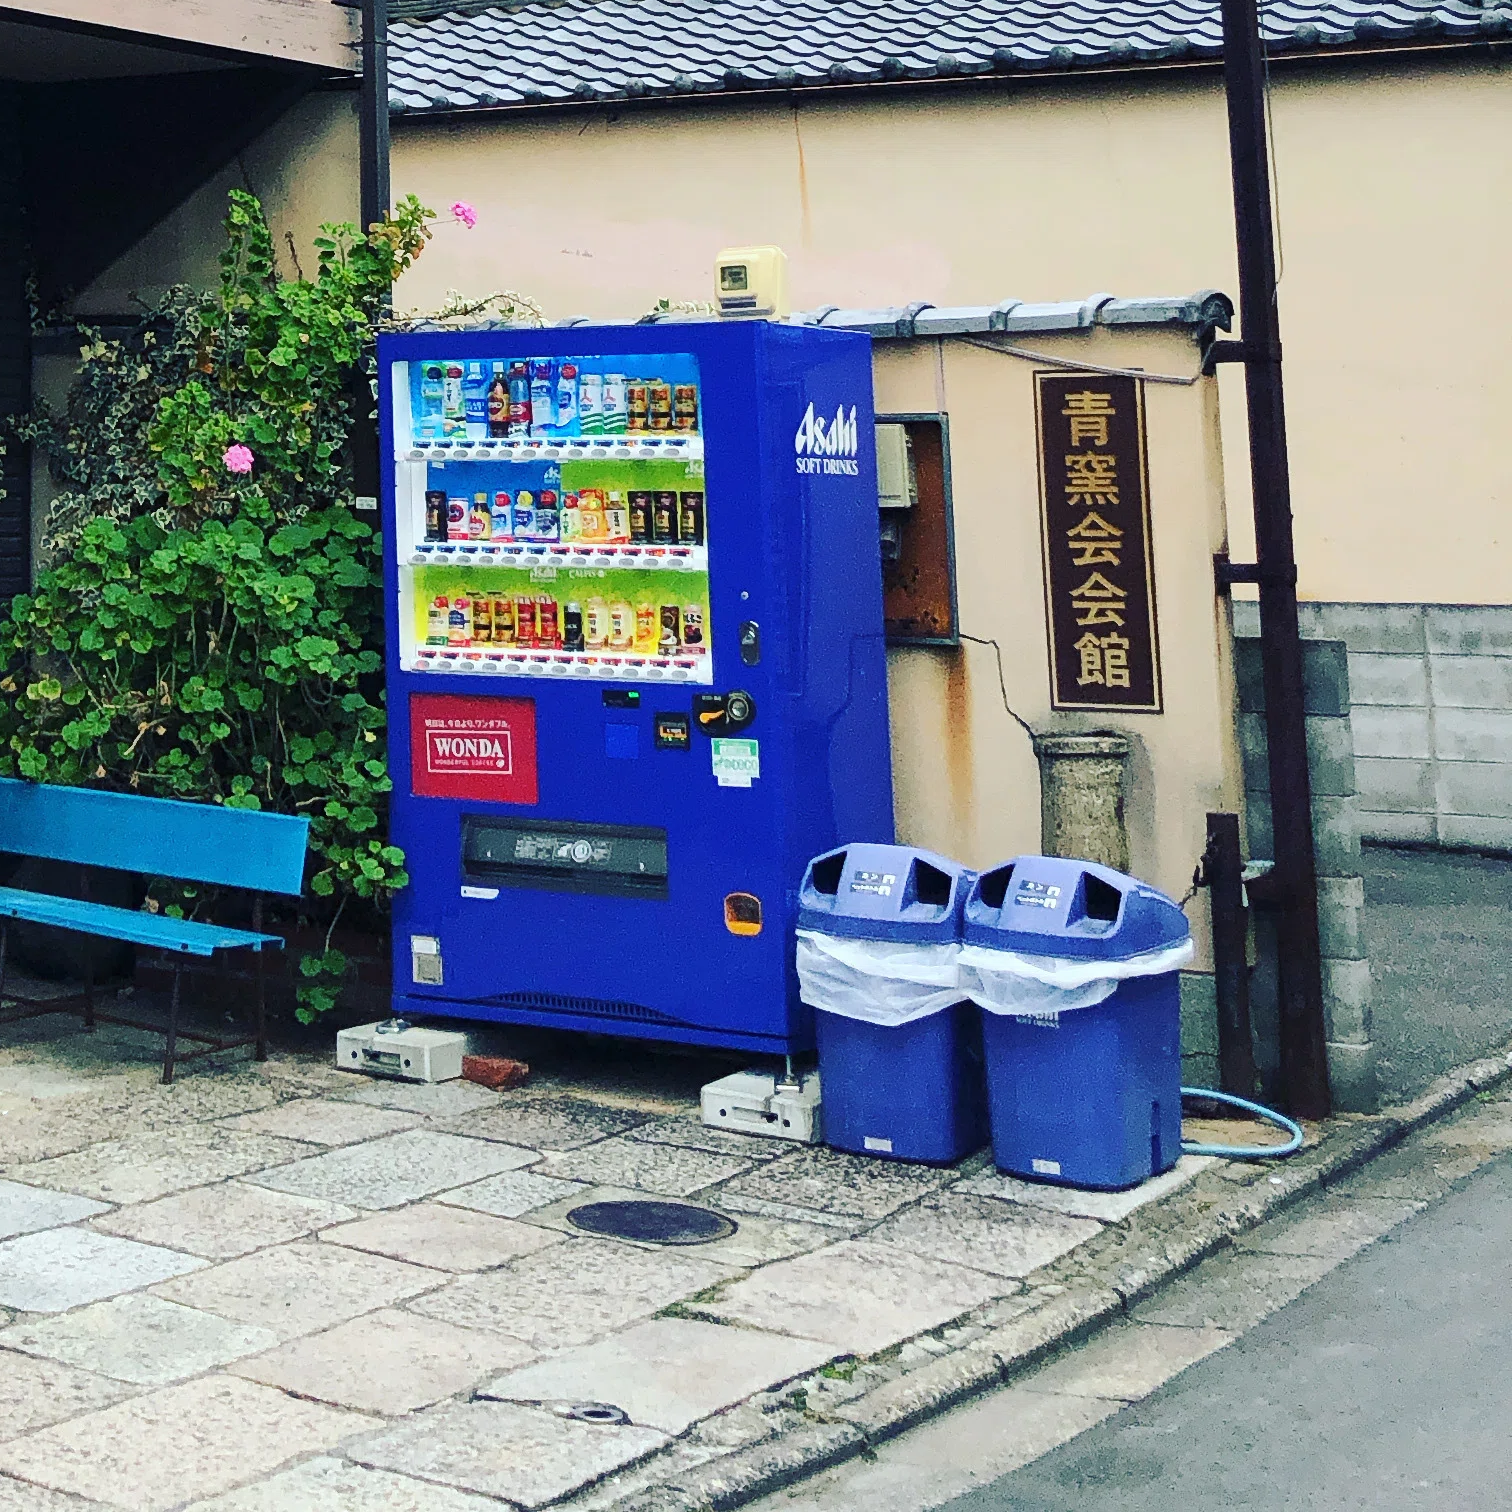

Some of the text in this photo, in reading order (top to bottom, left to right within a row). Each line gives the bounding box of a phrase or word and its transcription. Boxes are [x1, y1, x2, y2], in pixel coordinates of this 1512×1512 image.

[795, 401, 858, 457] Asahi
[796, 457, 859, 476] SOFT DRINKS
[1061, 390, 1131, 688] 青窯会会館
[433, 738, 504, 758] WONDA
